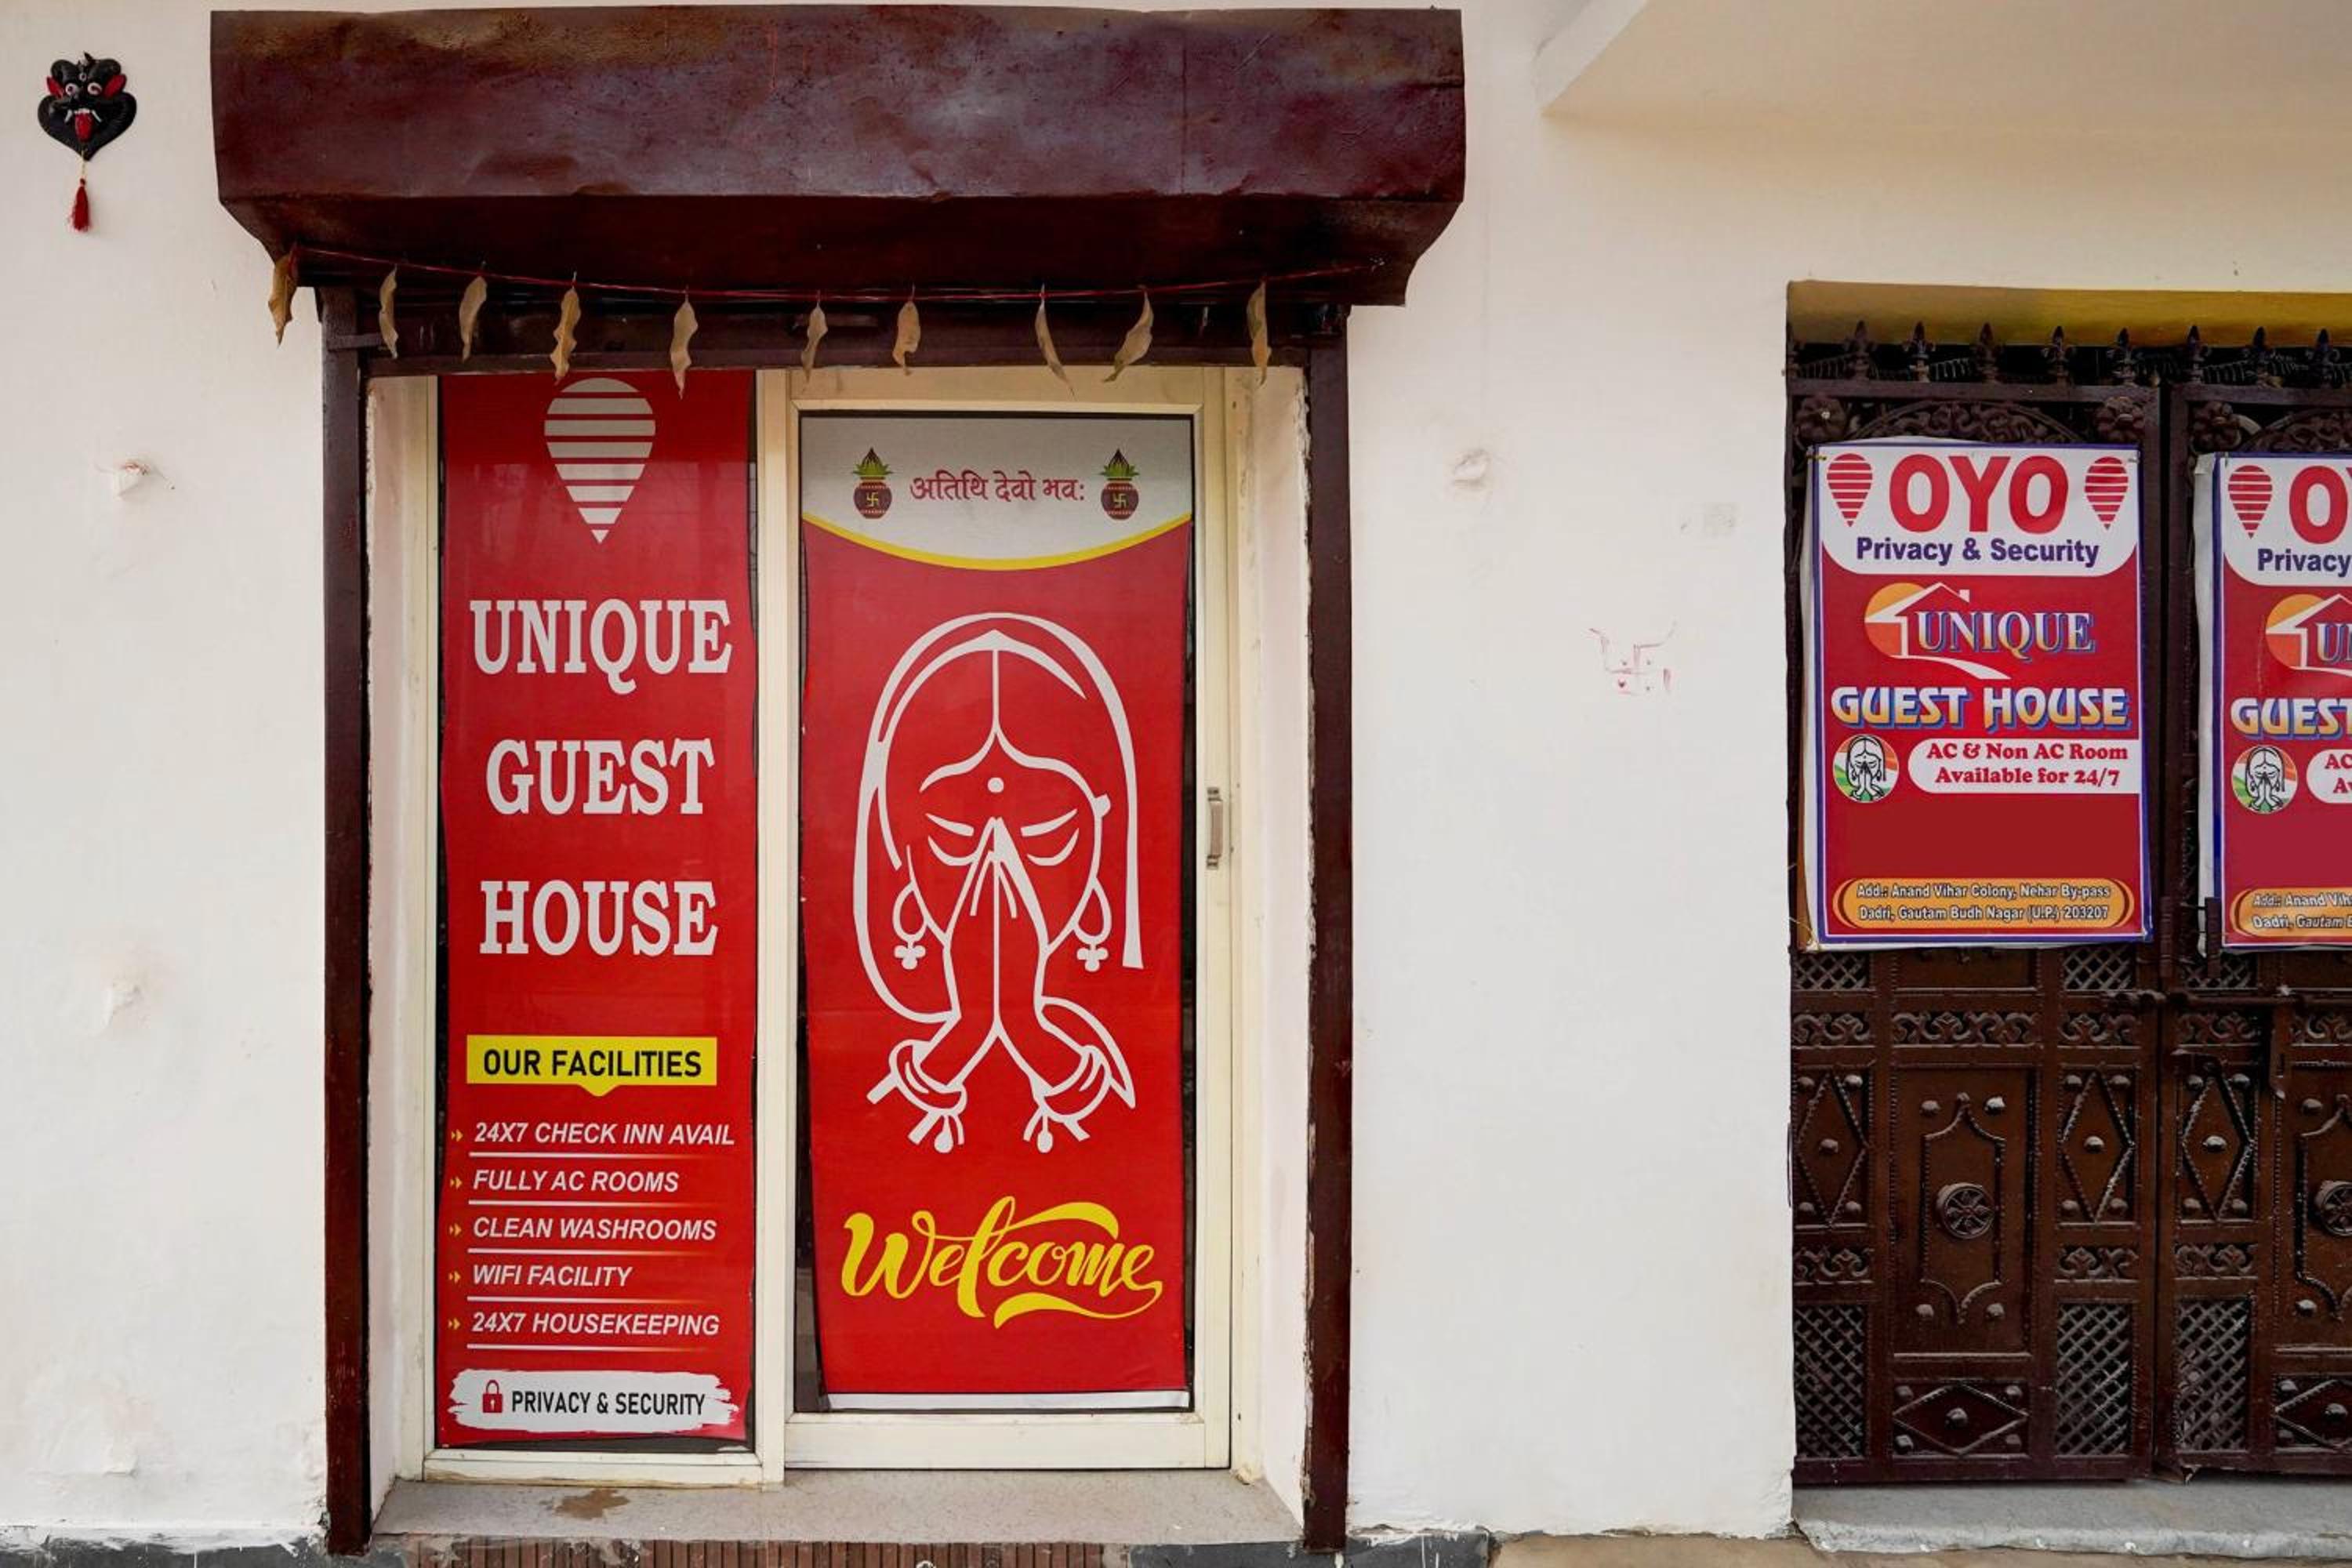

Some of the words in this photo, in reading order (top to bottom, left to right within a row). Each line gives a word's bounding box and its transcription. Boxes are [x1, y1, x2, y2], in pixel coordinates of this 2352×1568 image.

[910, 470, 989, 500] अतिथि
[993, 470, 1036, 502] देवो
[1889, 453, 2069, 535] OYO
[2288, 465, 2352, 544] O
[1856, 537, 1952, 566] Privacy
[1962, 537, 1981, 561] &
[1991, 537, 2100, 568] Security
[2257, 548, 2352, 577] Privacy
[470, 598, 731, 695] UNIQUE
[1915, 611, 2096, 662] UNIQUE
[1831, 686, 1970, 729] GUEST
[1984, 687, 2132, 733] HOUSE
[1926, 742, 1958, 760] AC
[1962, 742, 1981, 760] &
[1986, 742, 2029, 760] Non
[2034, 743, 2065, 760] AC
[2069, 743, 2129, 760] Room
[485, 738, 715, 815] GUEST
[1935, 767, 2034, 784] Available
[2038, 767, 2070, 783] for
[2074, 768, 2121, 787] 24/7
[1891, 883, 1931, 898] Anand
[1932, 883, 1967, 898] Vihar
[1970, 884, 2017, 899] Colony,
[2020, 883, 2058, 897] Nehar
[2060, 884, 2111, 899] By-pass
[2285, 892, 2326, 907] Anand
[480, 879, 718, 956] HOUSE
[1859, 905, 1895, 922] Dadri,
[1898, 906, 1947, 920] Gautam
[1950, 905, 1983, 920] Budh
[1985, 906, 2024, 922] Nagar
[2063, 906, 2109, 920] 203207
[2296, 914, 2344, 928] Gautam
[483, 1050, 541, 1076] OUR
[552, 1050, 702, 1077] FACILITIES
[474, 1121, 529, 1142] 24X7
[535, 1123, 617, 1145] CHECK
[622, 1123, 665, 1145] INN
[668, 1124, 735, 1145] AVAIL
[473, 1169, 548, 1191] FULLY
[550, 1171, 585, 1192] AC
[590, 1171, 680, 1192] ROOMS
[474, 1217, 554, 1239] CLEAN
[559, 1218, 717, 1240] WASHROOMS
[841, 1196, 1163, 1329] Welcome
[473, 1265, 522, 1285] WIFI
[527, 1265, 633, 1287] FACILITY
[472, 1312, 527, 1333] 24X7
[532, 1312, 720, 1335] HOUSEKEEPING
[511, 1391, 591, 1414] PRIVACY
[596, 1392, 609, 1414] &
[615, 1392, 706, 1415] SECURITY
